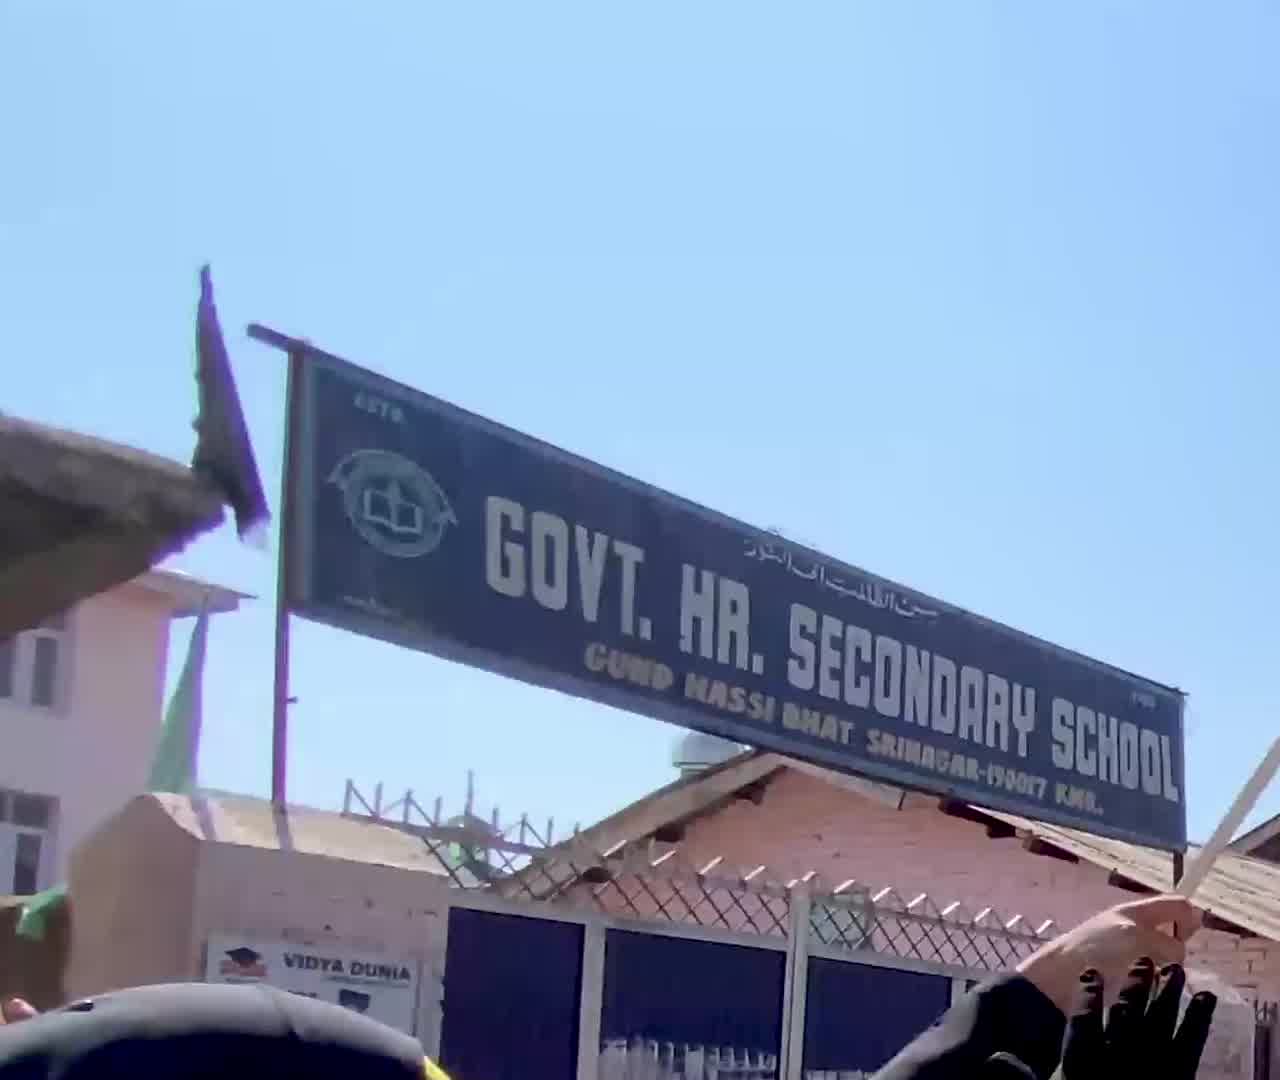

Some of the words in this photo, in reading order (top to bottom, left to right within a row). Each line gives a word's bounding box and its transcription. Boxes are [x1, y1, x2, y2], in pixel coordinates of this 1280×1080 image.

[485, 496, 652, 641] GOVT.
[679, 563, 764, 675] HR.
[788, 603, 1036, 757] SECONDARY
[1051, 697, 1179, 802] SCHOOL
[282, 952, 345, 973] VIDYA
[350, 961, 411, 980] DUNIA
